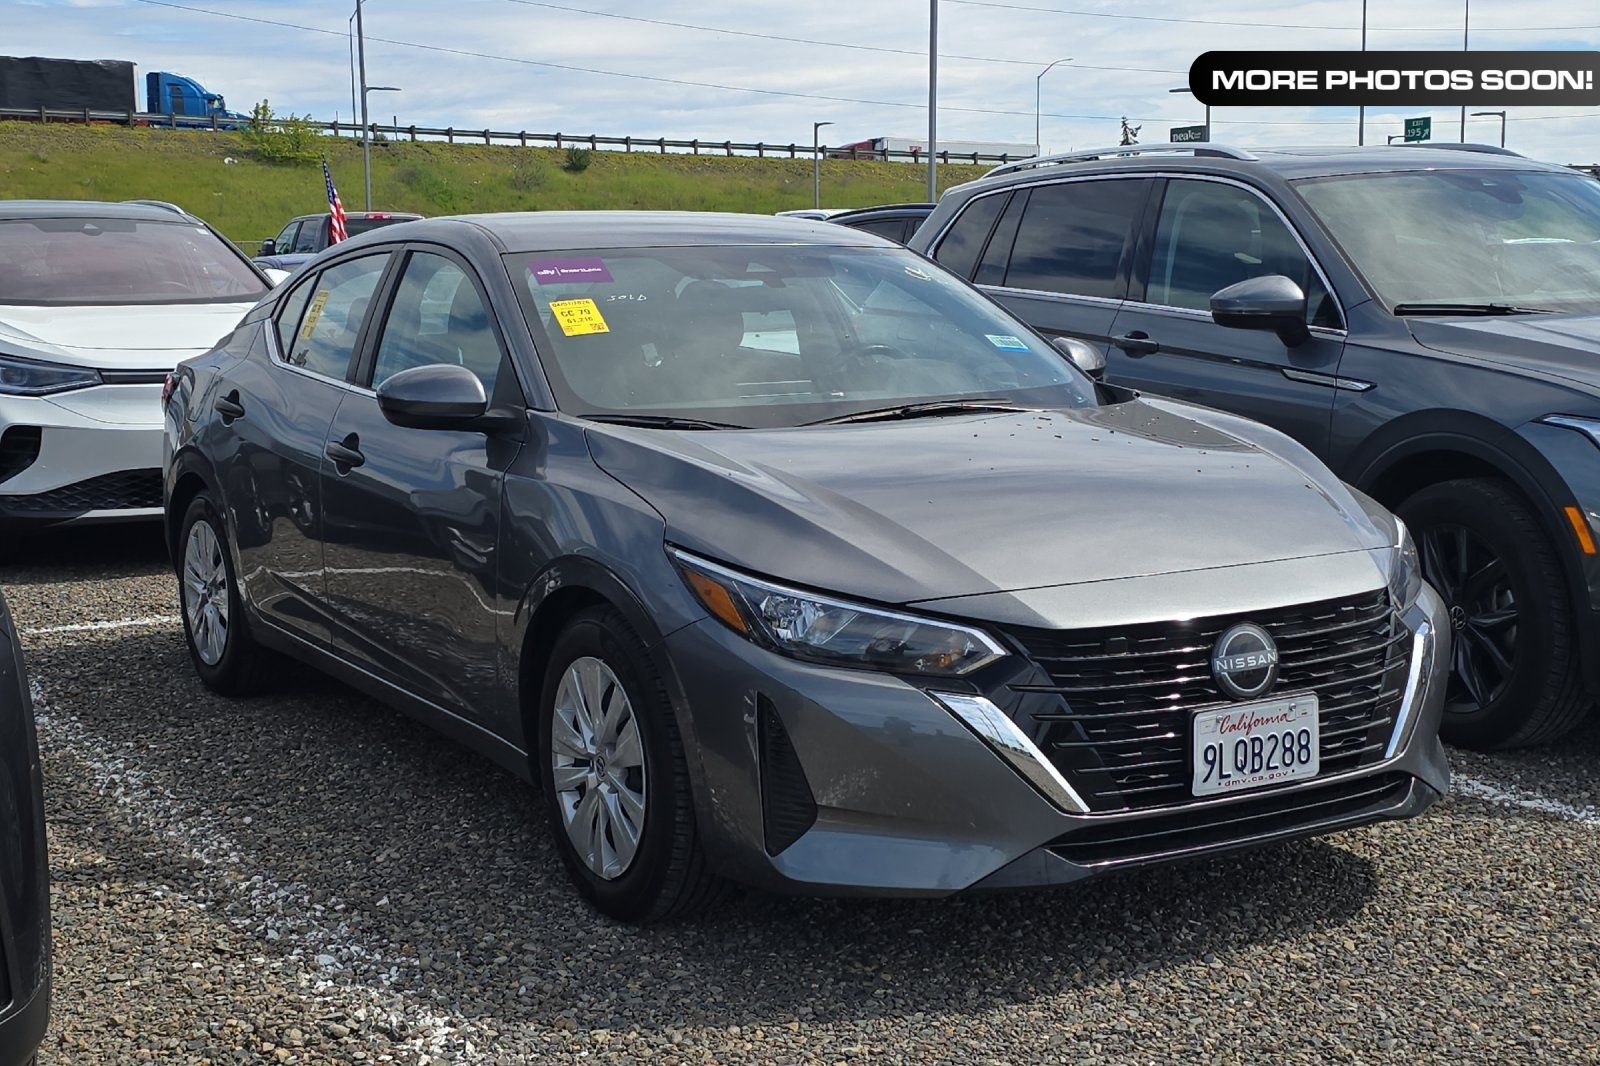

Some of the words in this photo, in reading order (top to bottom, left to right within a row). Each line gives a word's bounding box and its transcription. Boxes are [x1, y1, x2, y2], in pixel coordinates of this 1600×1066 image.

[1172, 130, 1195, 142] peak
[1216, 652, 1278, 670] NISSAN
[1220, 708, 1296, 736] California
[1202, 728, 1311, 783] 9LQB288
[1224, 770, 1289, 787] dmv.ca.gov
